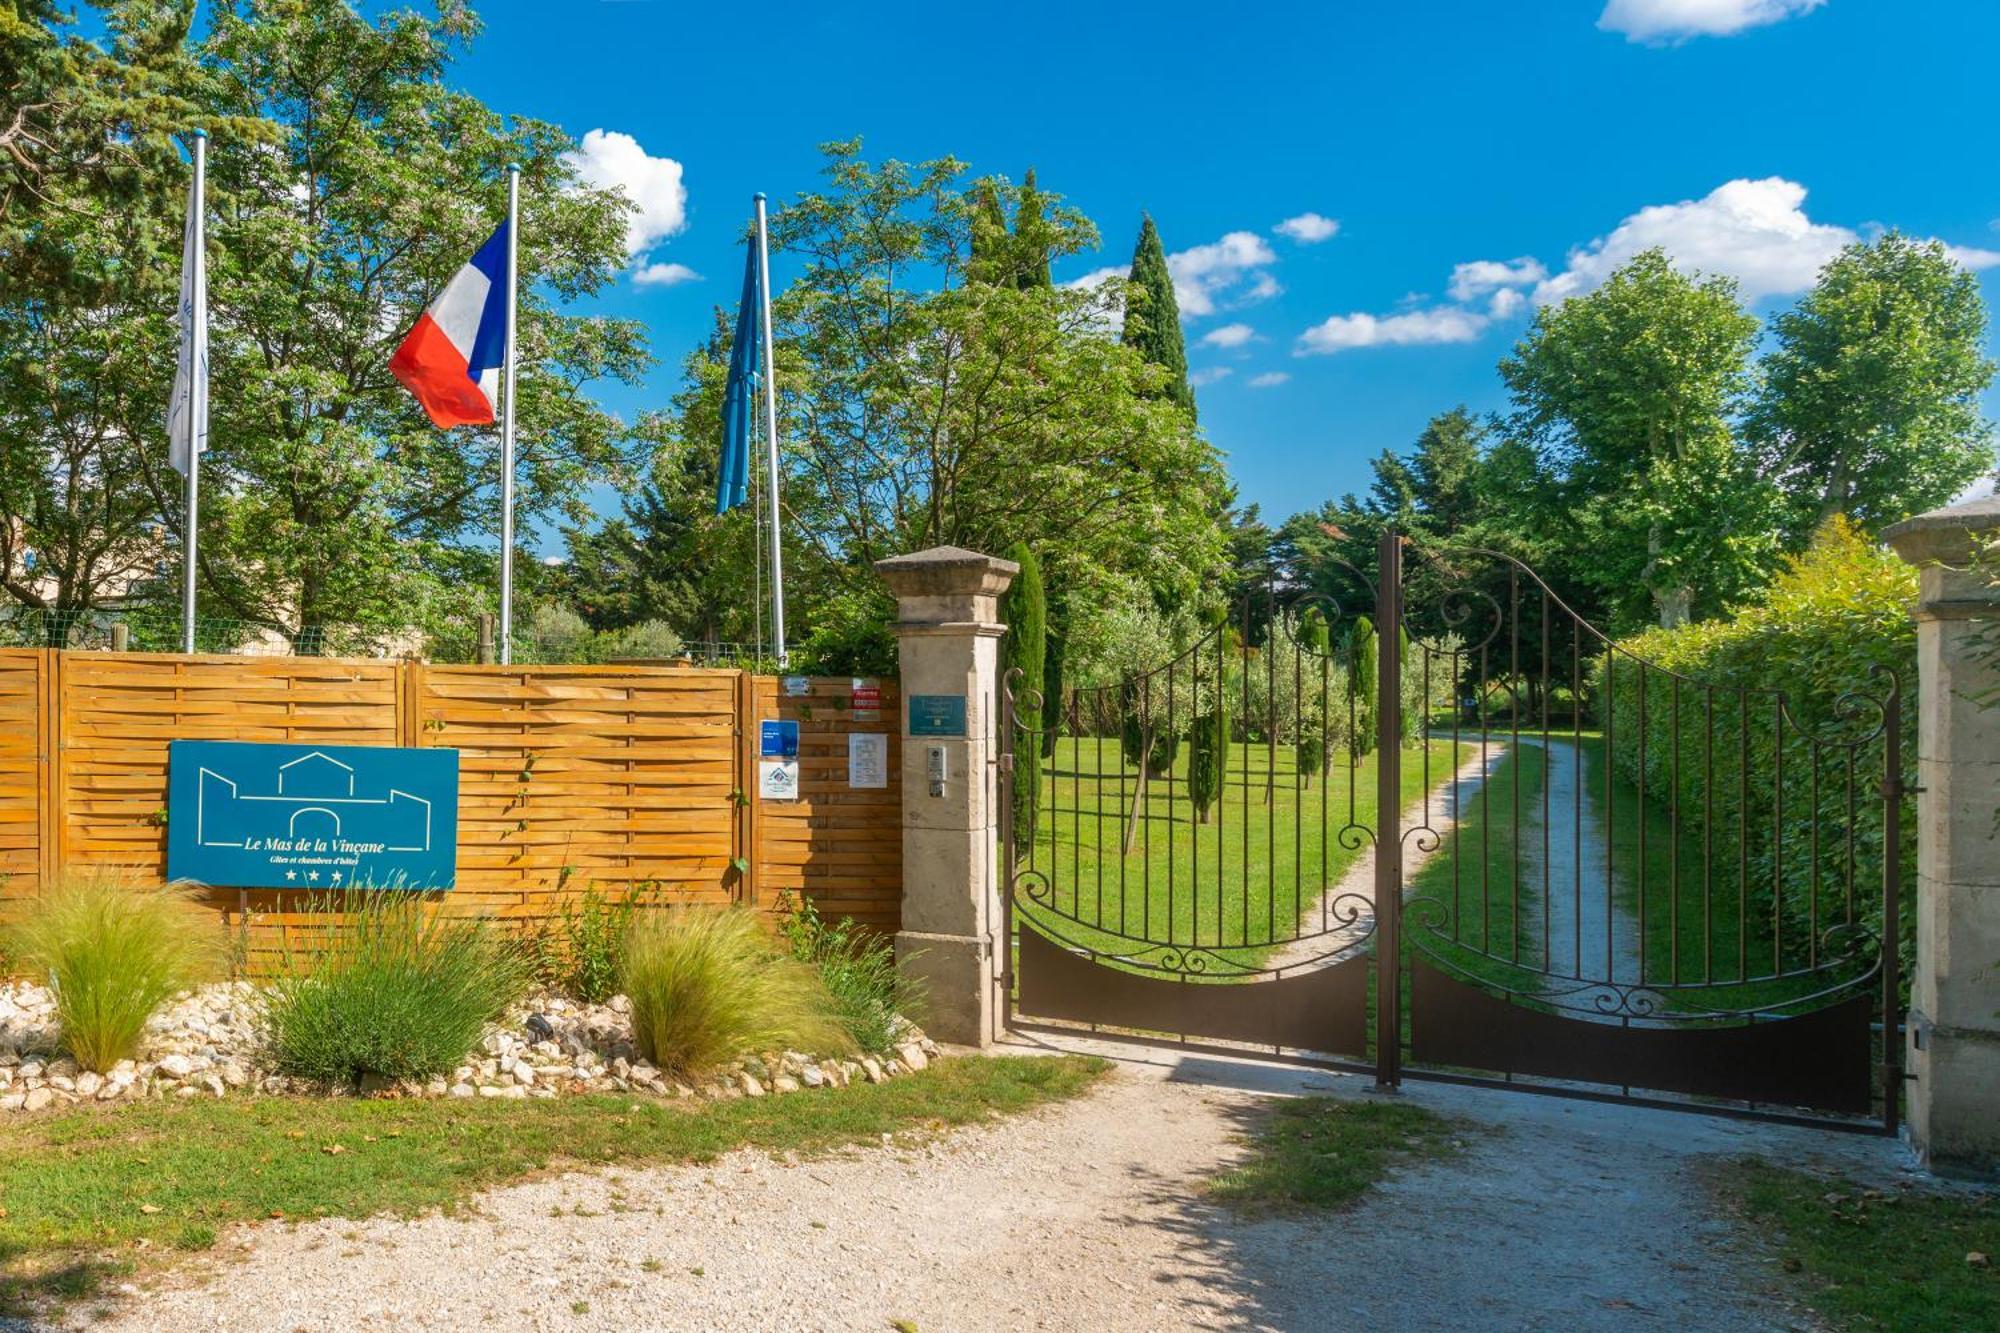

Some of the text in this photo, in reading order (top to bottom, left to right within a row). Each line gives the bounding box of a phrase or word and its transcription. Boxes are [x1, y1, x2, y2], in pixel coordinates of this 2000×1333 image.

[244, 837, 385, 854] Le Mas de la Vinçane
